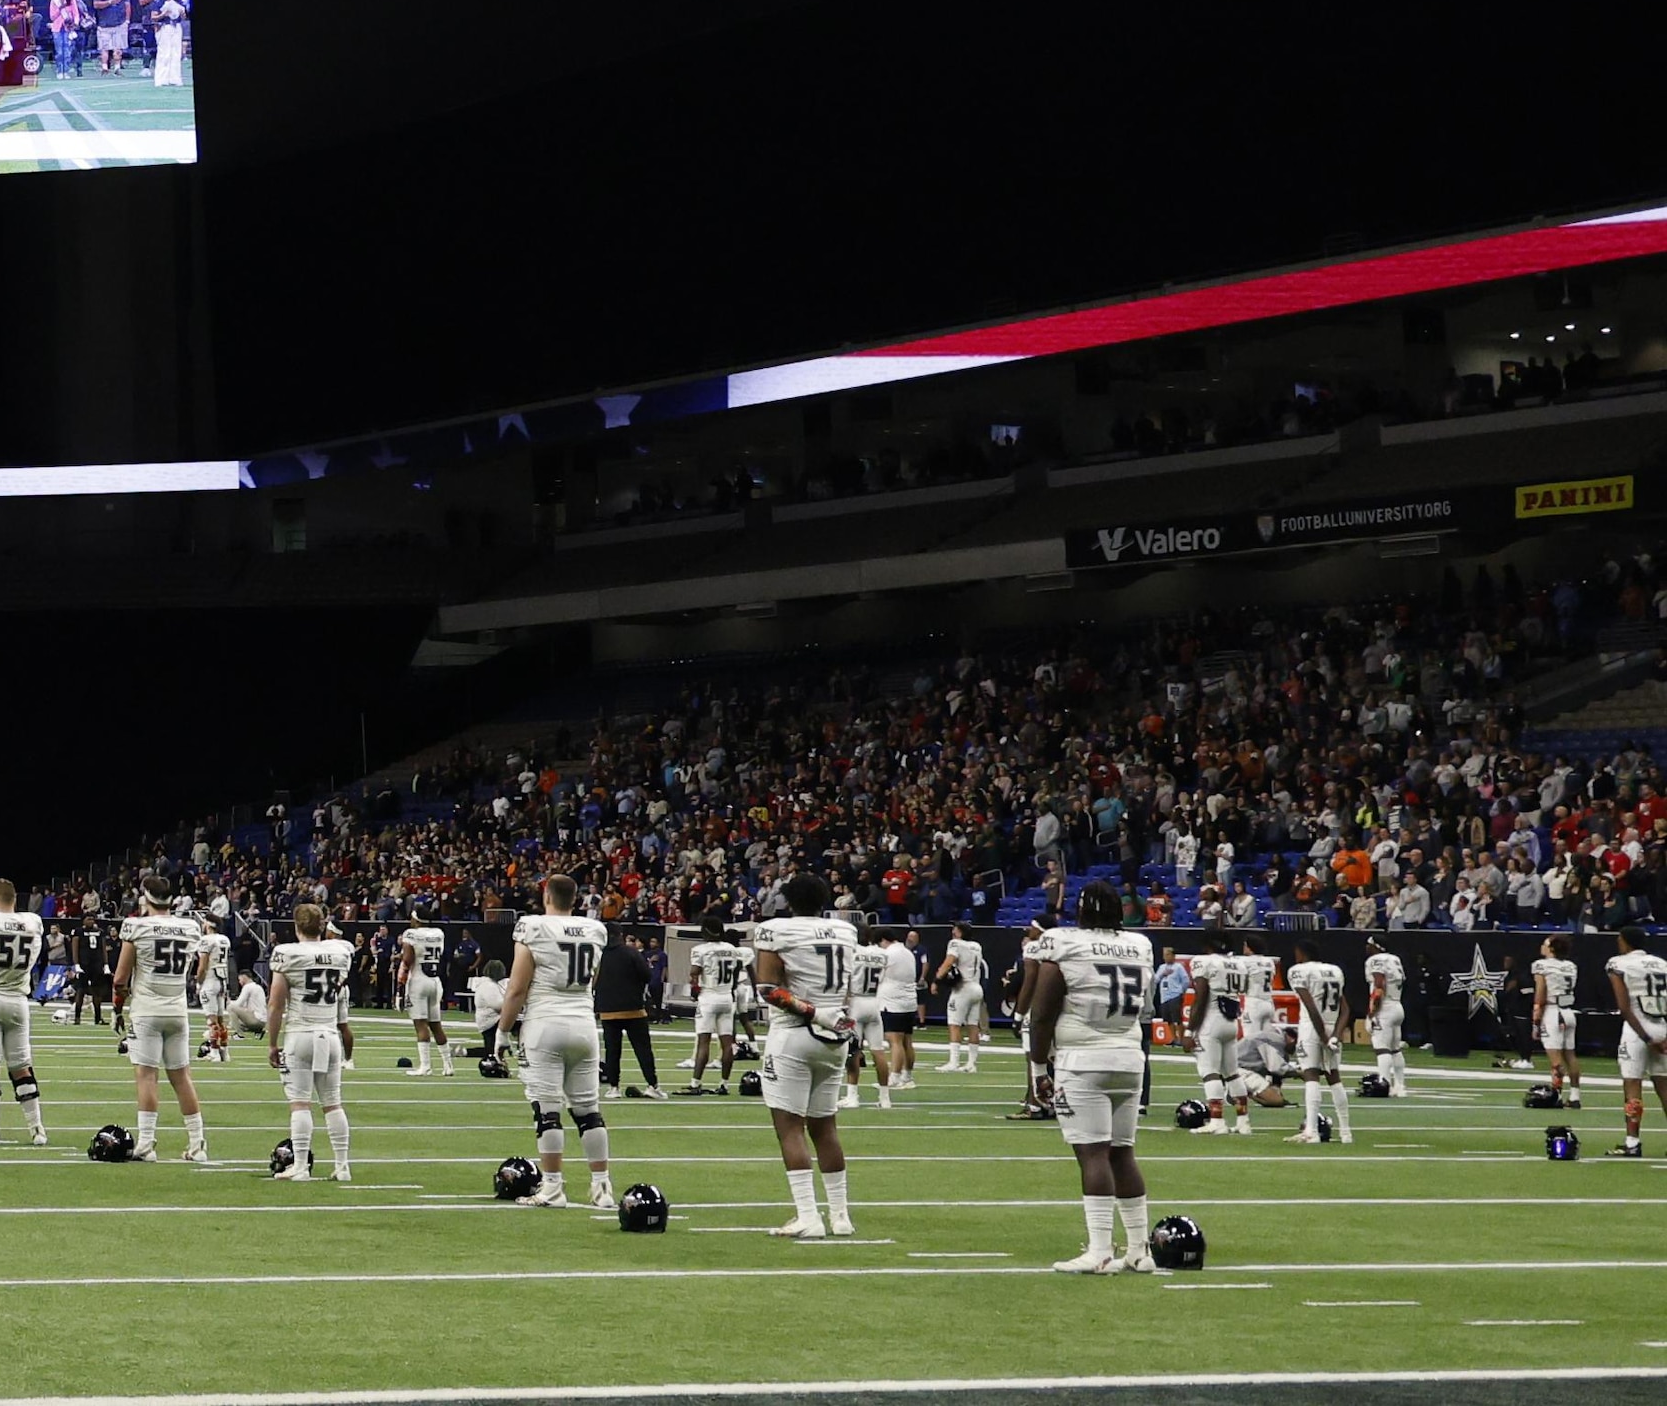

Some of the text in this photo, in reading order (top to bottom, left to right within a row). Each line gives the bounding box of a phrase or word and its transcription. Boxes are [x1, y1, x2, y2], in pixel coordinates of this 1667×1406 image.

[1523, 484, 1625, 510] PANINI
[1135, 527, 1220, 555] Valero
[563, 925, 585, 937] MOORE
[153, 939, 189, 975] 56
[315, 954, 332, 966] MILLS
[1092, 942, 1139, 959] ECHOLES
[556, 942, 594, 988] 70
[717, 960, 732, 984] 16
[813, 944, 844, 994] 71
[1093, 963, 1142, 1019] 72
[1226, 973, 1241, 994] 14
[1322, 981, 1341, 1012] 13
[1156, 1026, 1165, 1039] G
